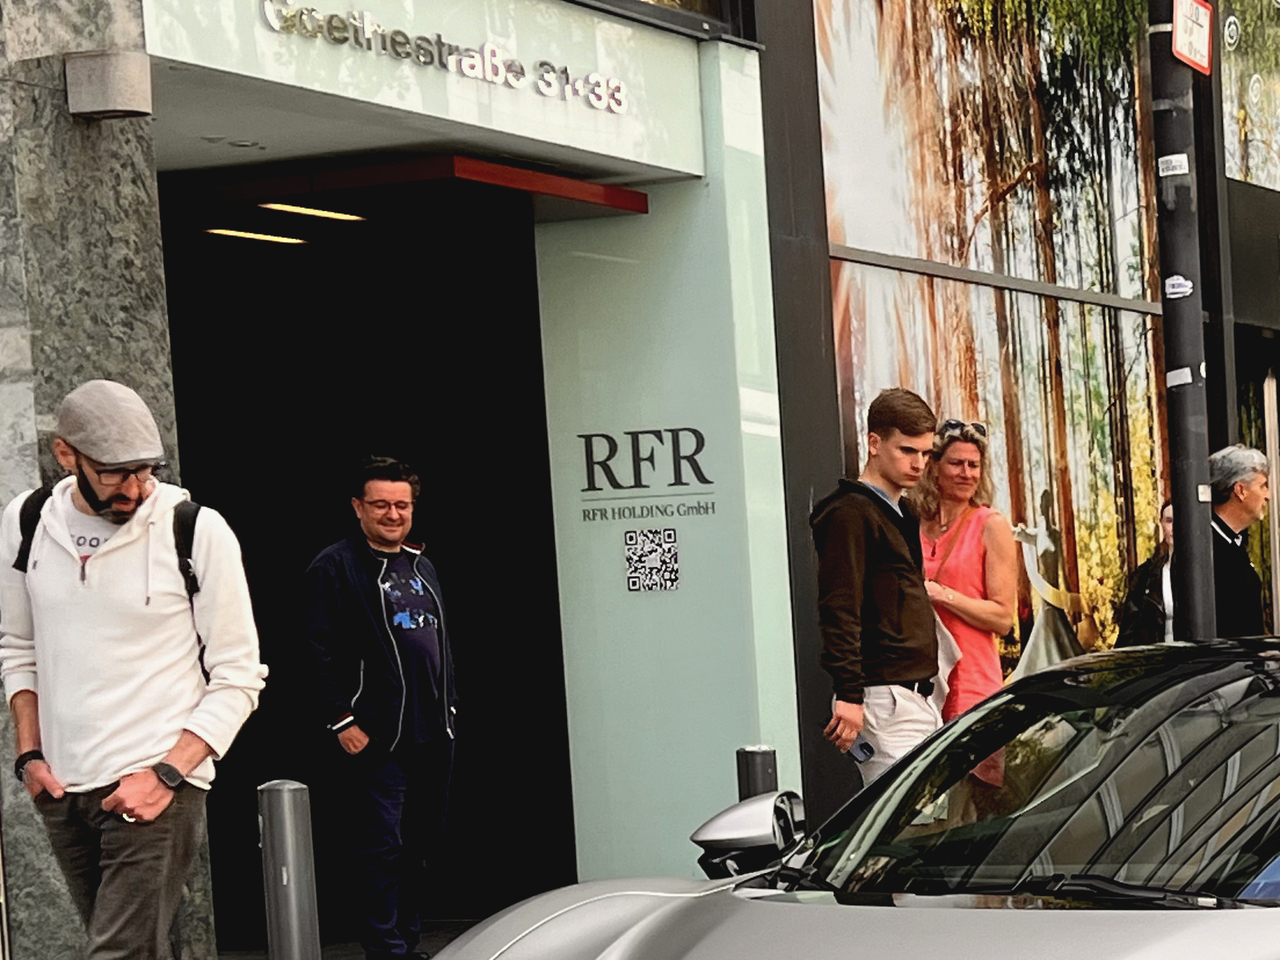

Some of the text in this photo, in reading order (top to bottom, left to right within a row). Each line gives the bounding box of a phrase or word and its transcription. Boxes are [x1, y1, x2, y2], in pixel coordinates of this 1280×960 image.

[258, 0, 527, 89] Goethestraße
[577, 427, 715, 492] RFR
[582, 501, 716, 522] RFR HOLDING GmbH
